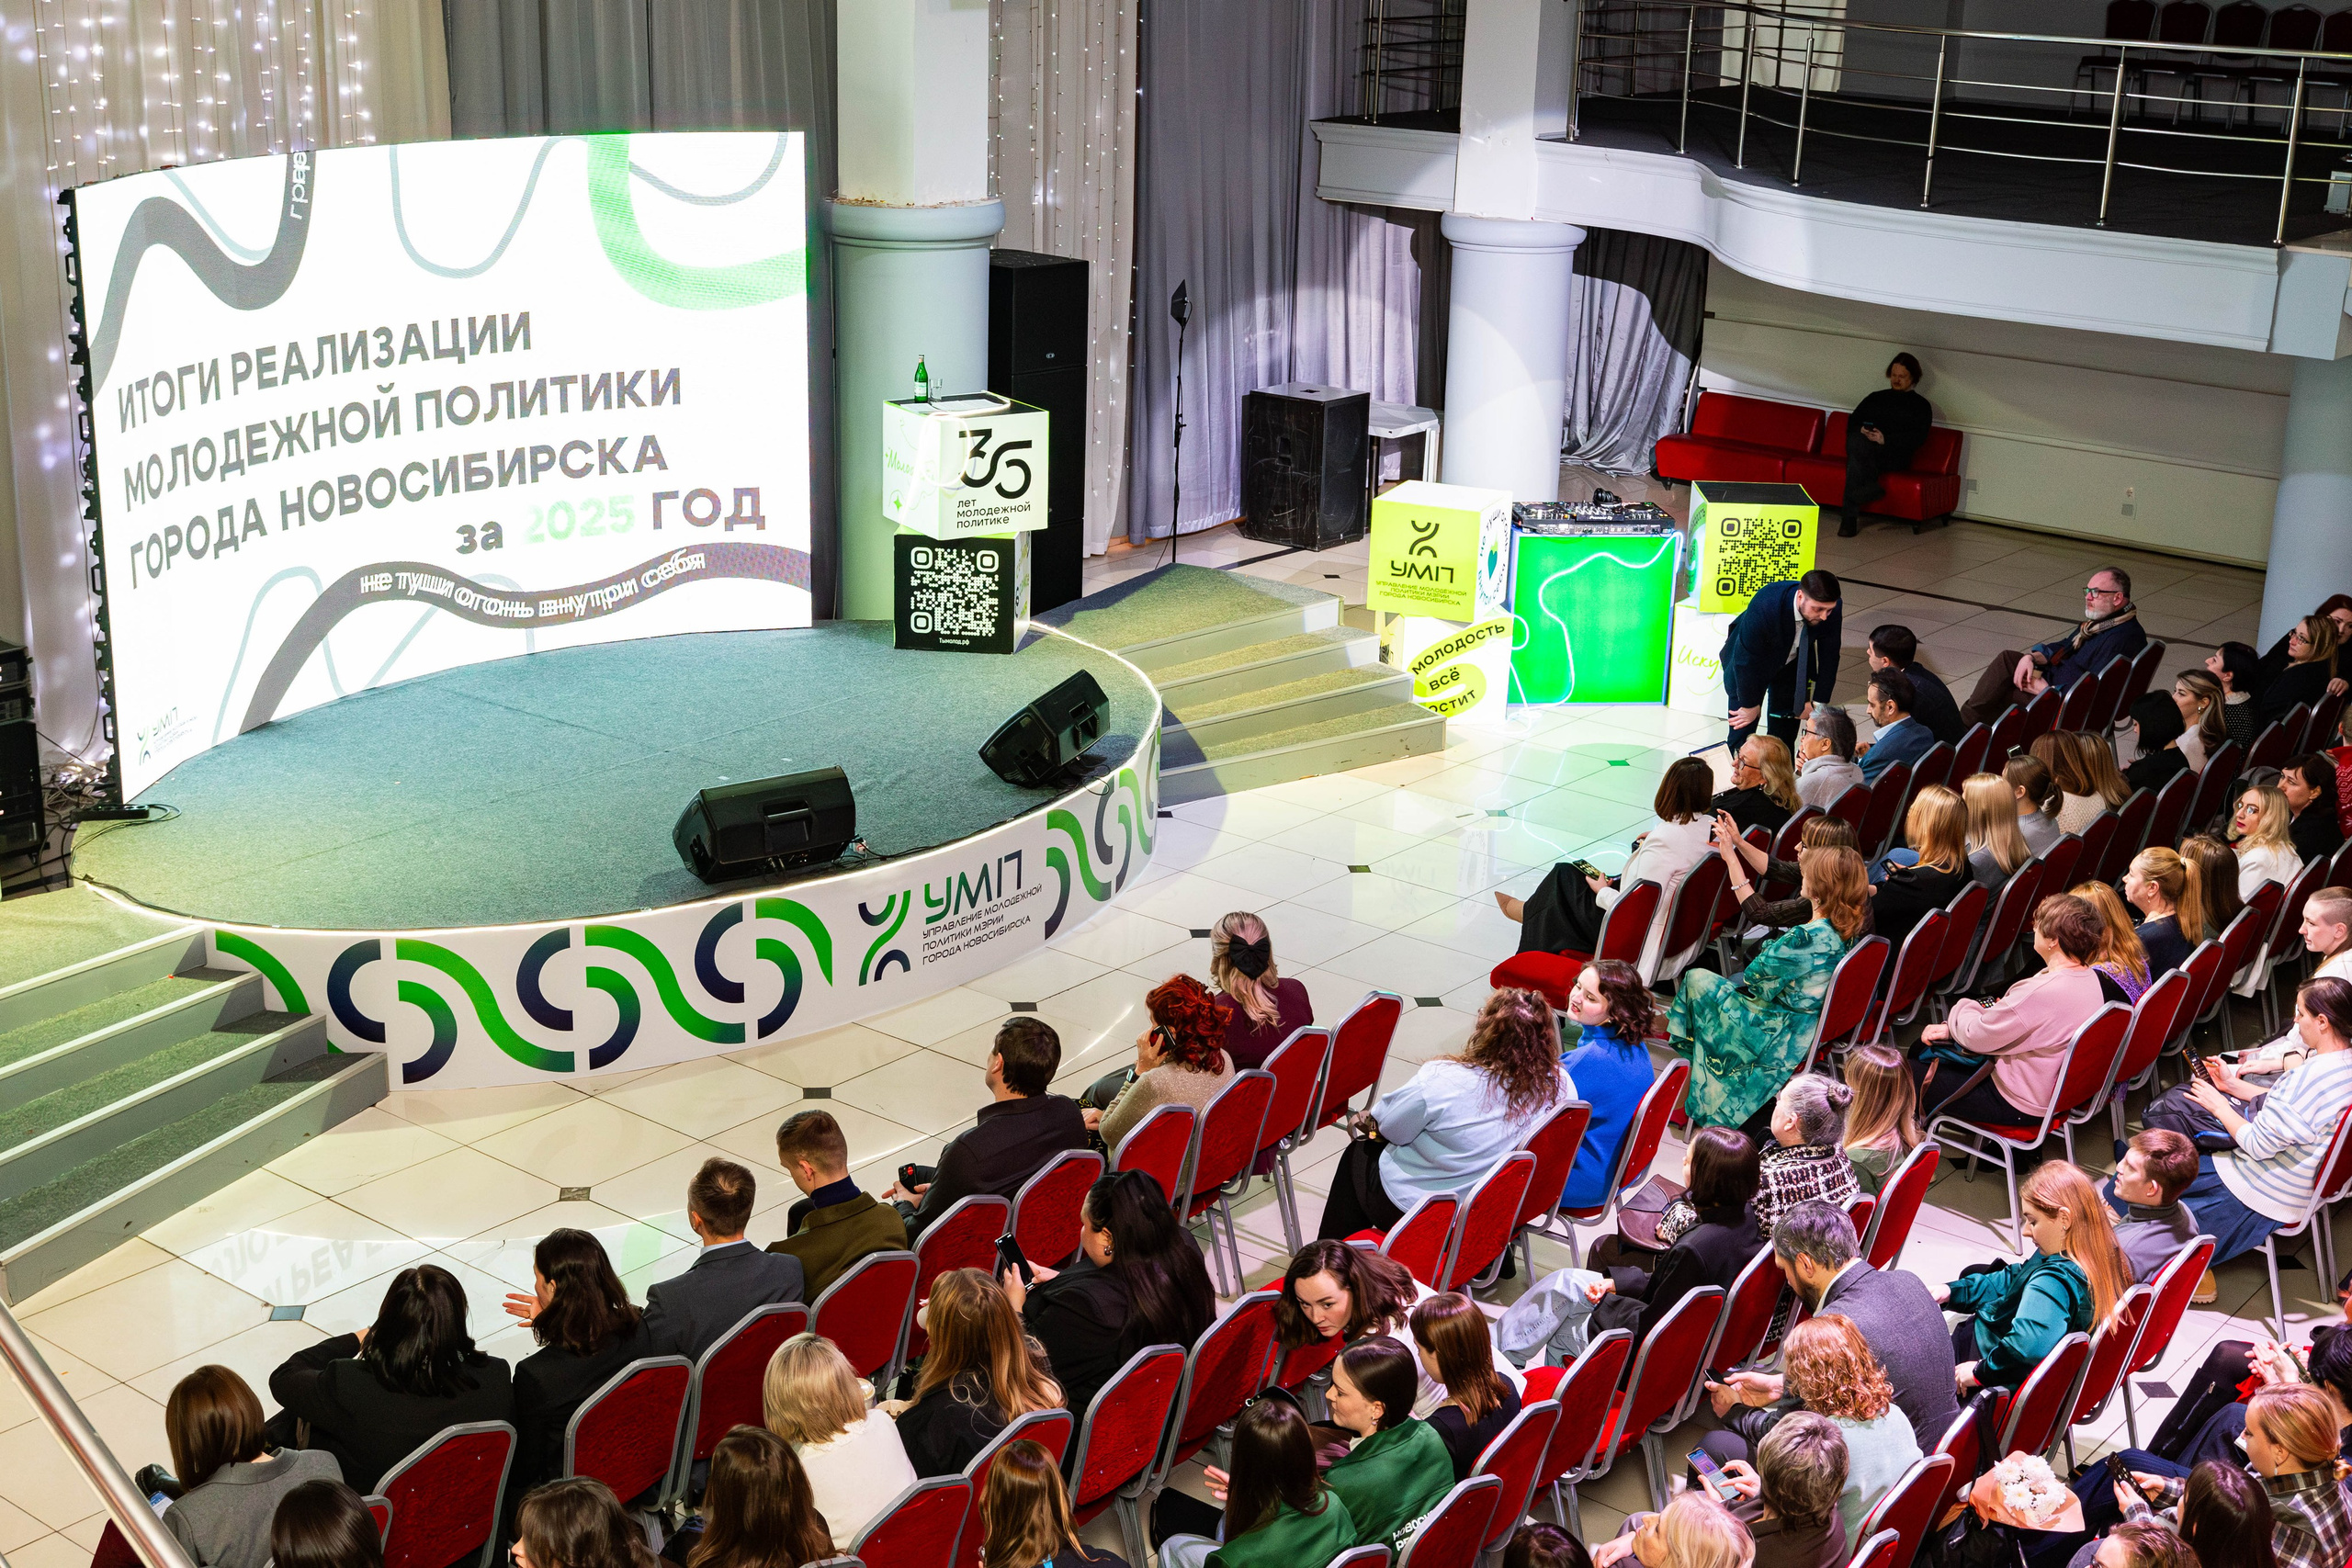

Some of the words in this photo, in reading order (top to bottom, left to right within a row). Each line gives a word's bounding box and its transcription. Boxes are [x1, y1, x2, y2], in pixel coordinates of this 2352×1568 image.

[118, 357, 220, 434] ИТОГИ
[231, 310, 531, 396] РЕАЛИЗАЦИИ
[123, 382, 401, 513] МОЛОДЕЖНОЙ
[414, 367, 681, 432] ПОЛИТИКИ
[958, 428, 1033, 500] 35
[130, 498, 268, 590] ГОРОДА
[279, 434, 669, 532] НОВОСИБИРСКА
[455, 520, 503, 555] за
[523, 494, 636, 545] 2025
[651, 486, 766, 532] ГОД
[956, 499, 978, 509] лет
[956, 501, 1031, 518] молодежной
[956, 516, 1010, 529] политике
[1375, 580, 1419, 591] УПРАВЛЕНИЕ
[1419, 586, 1467, 596] МОЛОДЕЖНОЙ
[1390, 559, 1454, 584] УМП
[1379, 591, 1407, 599] ГОРОДА
[1407, 594, 1461, 606] НОВОСИБИРСКА
[1390, 587, 1425, 596] ПОЛИТИКИ
[1677, 645, 1724, 681] Иску
[923, 849, 1023, 925] УМП
[922, 909, 983, 940] УПРАВЛЕНИЕ
[983, 883, 1043, 917] МОЛОДЕЖНОЙ
[922, 927, 972, 953] ПОЛИТИКИ
[973, 914, 1004, 934] МЭРИИ
[922, 944, 962, 965] ГОРОДА
[963, 915, 1031, 951] НОВОСИБИРСКА
